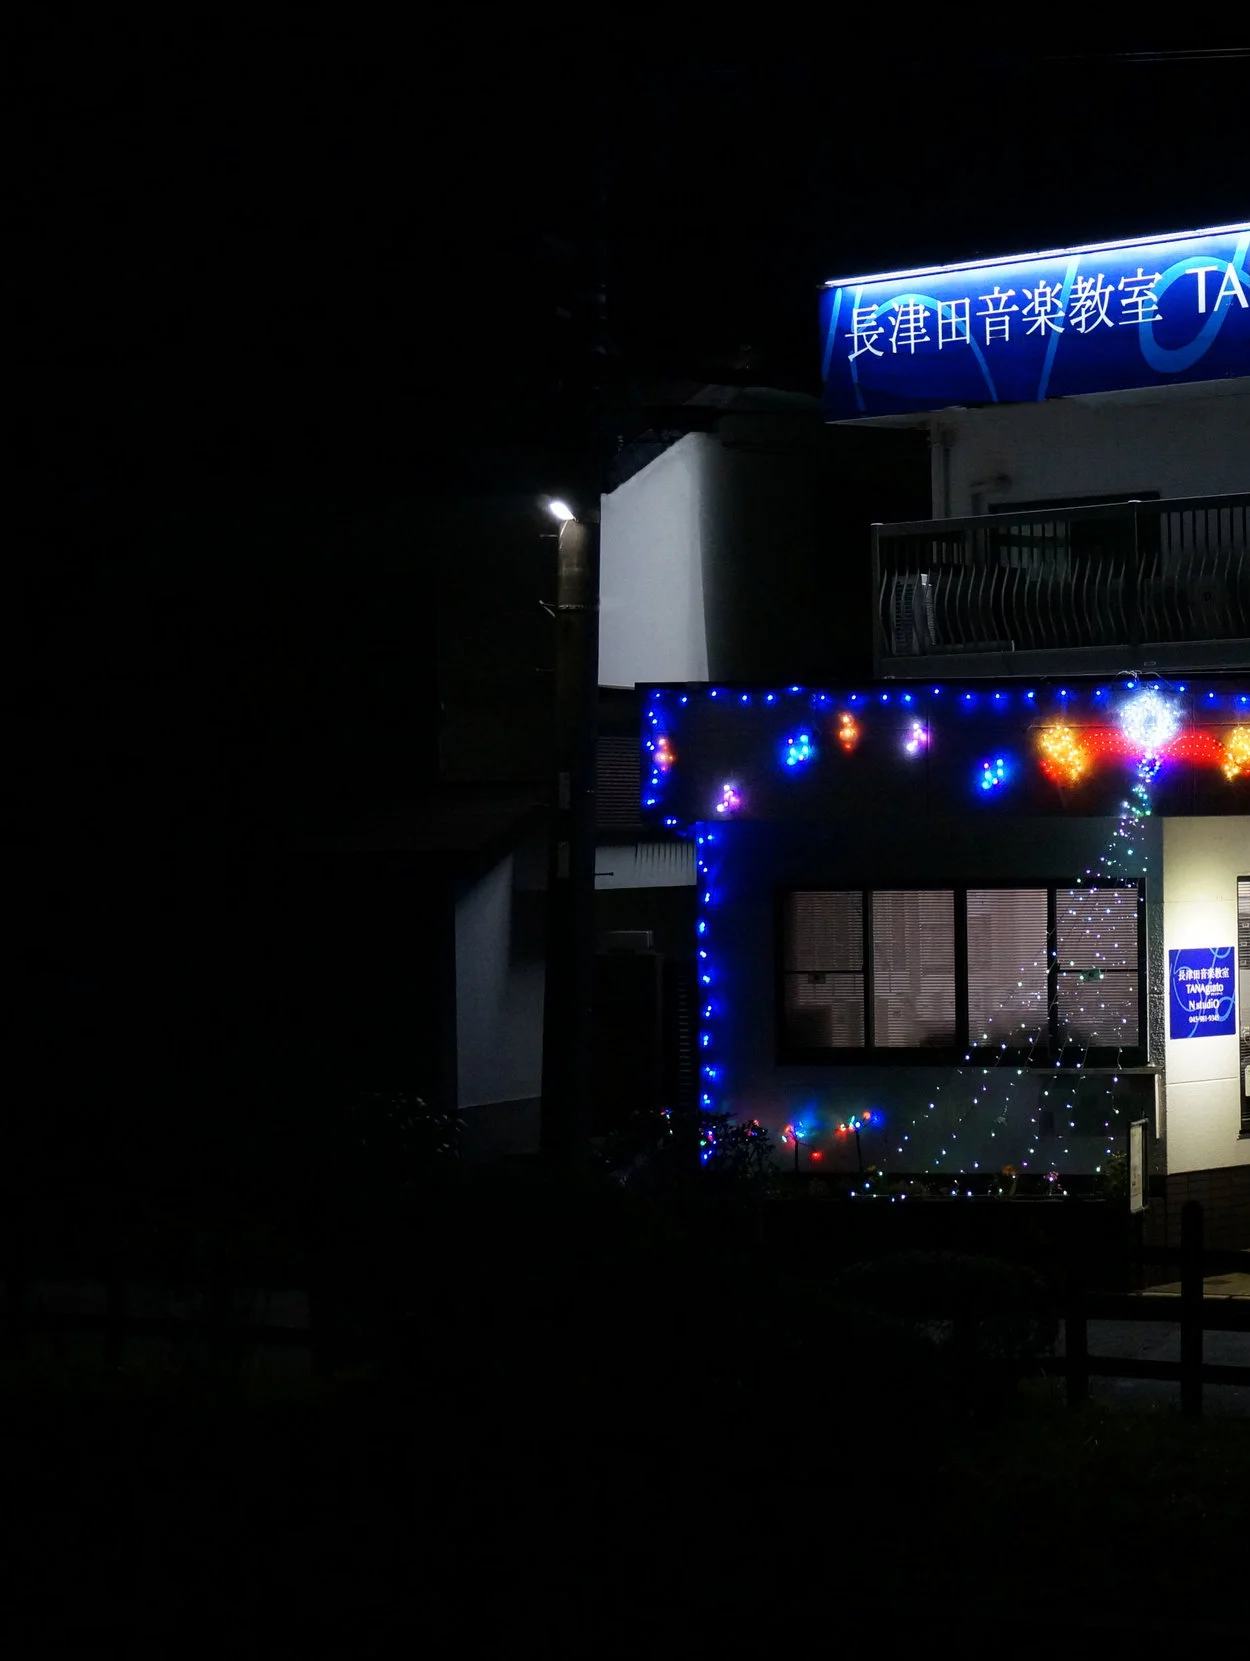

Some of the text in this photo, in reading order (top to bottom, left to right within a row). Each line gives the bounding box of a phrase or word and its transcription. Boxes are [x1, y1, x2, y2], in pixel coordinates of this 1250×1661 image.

[843, 267, 1165, 362] 長津田音楽教室
[1178, 967, 1230, 981] 長津田音楽教室
[1186, 982, 1224, 995] TANAgiato
